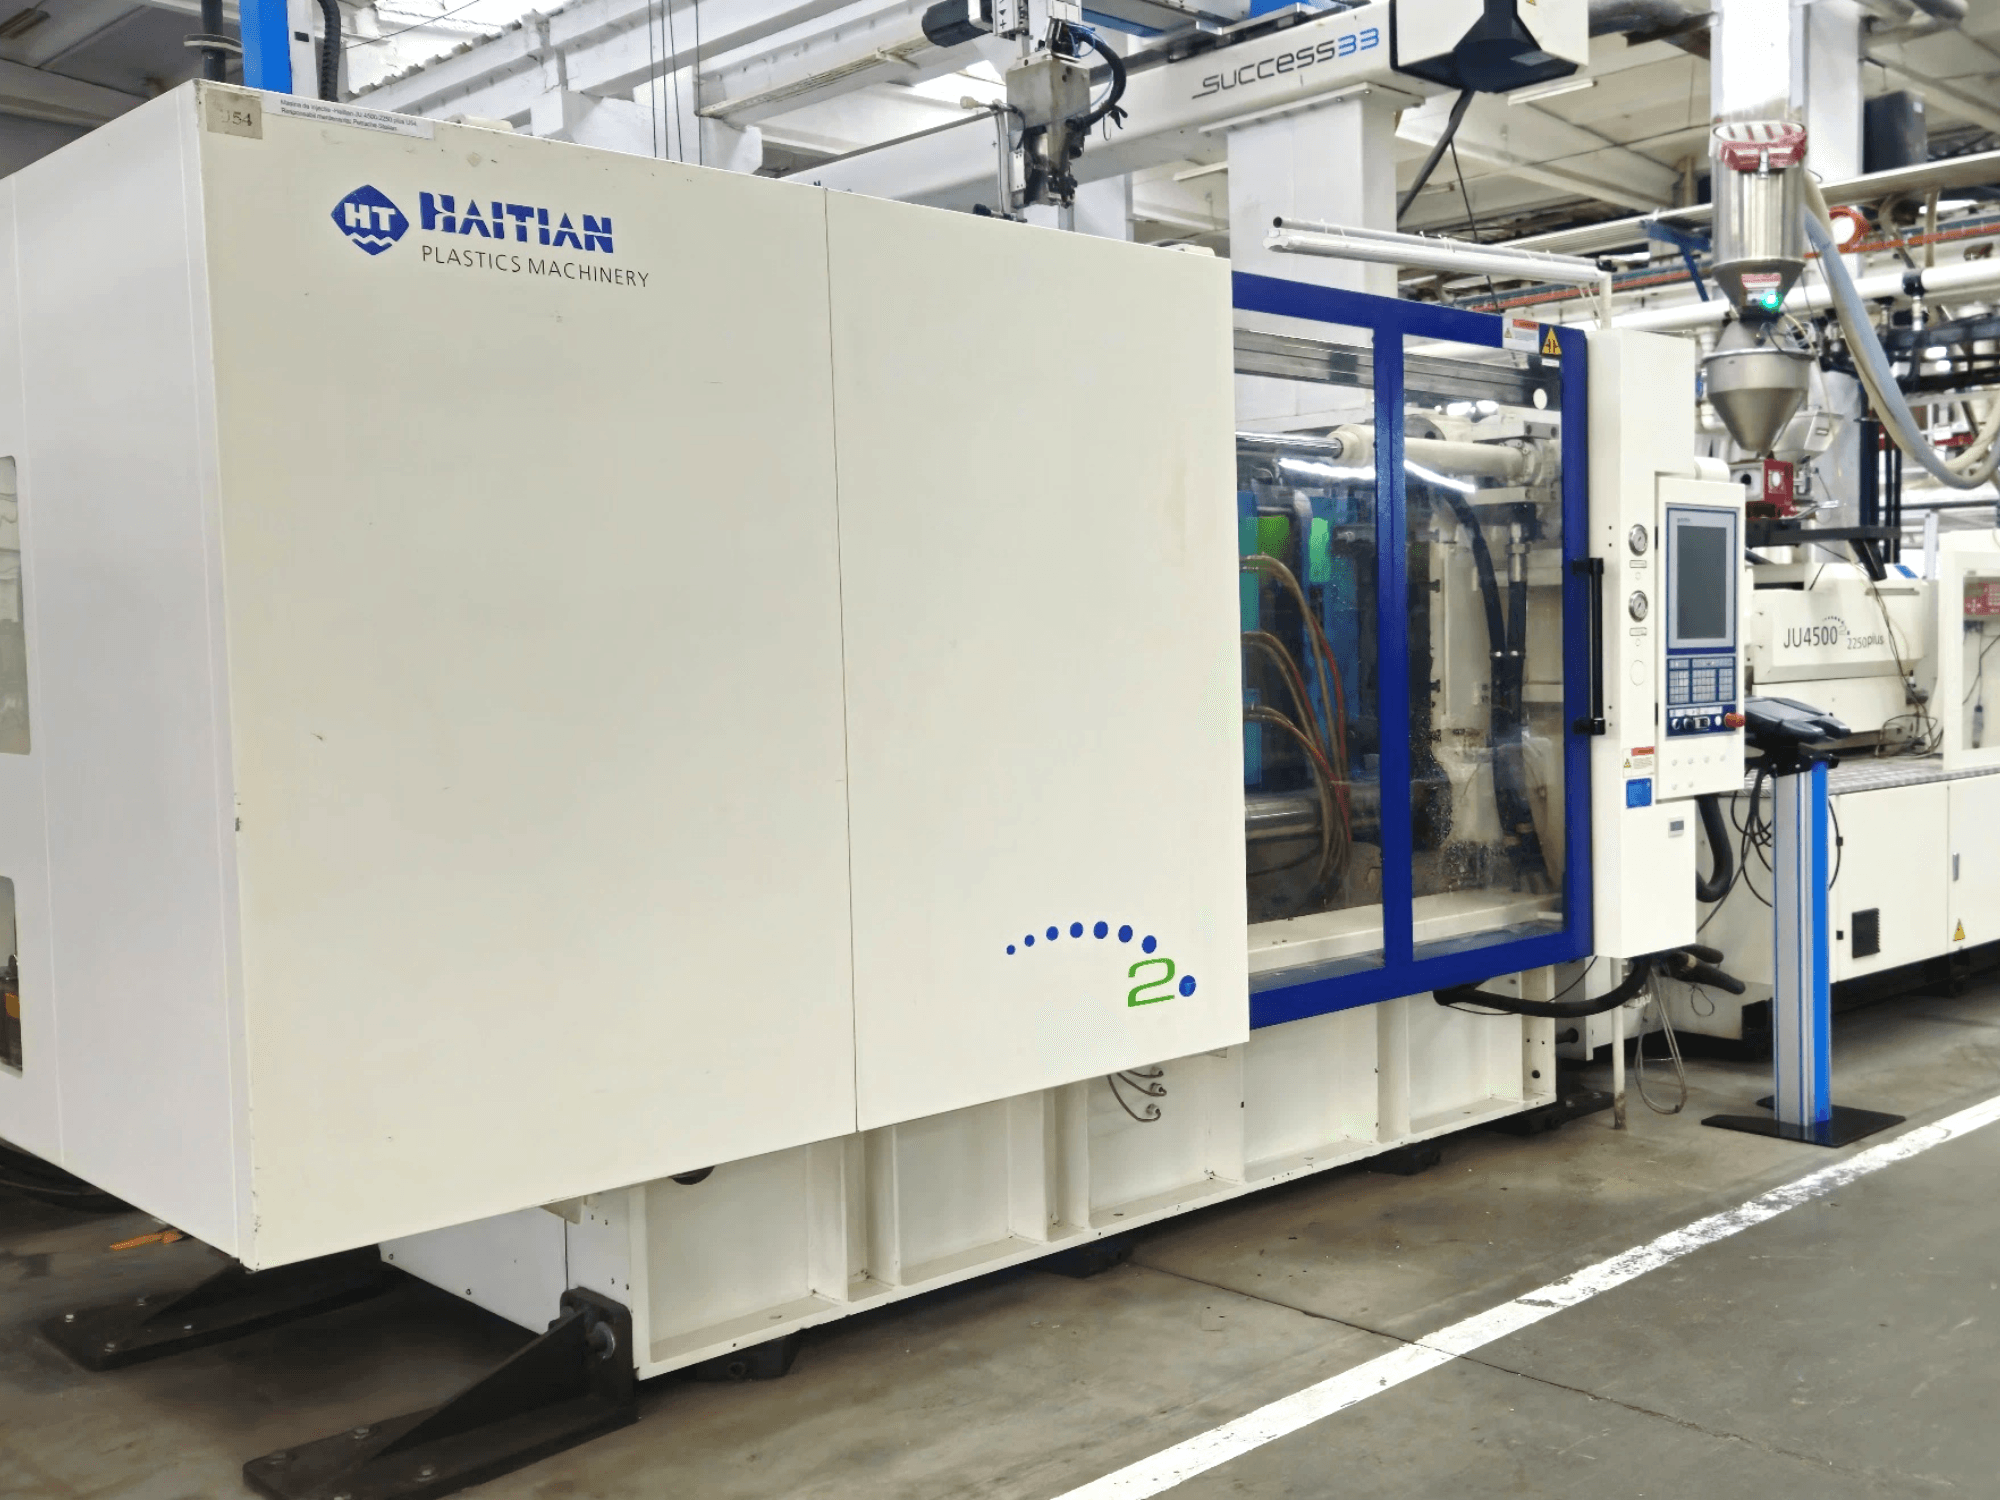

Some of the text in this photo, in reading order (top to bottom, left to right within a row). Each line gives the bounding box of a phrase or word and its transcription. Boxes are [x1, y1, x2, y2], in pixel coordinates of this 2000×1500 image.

[344, 202, 397, 231] HT
[419, 191, 614, 254] HAITIAN
[421, 245, 649, 288] PLASTICS MACHINERY
[1783, 626, 1838, 649] JU4500
